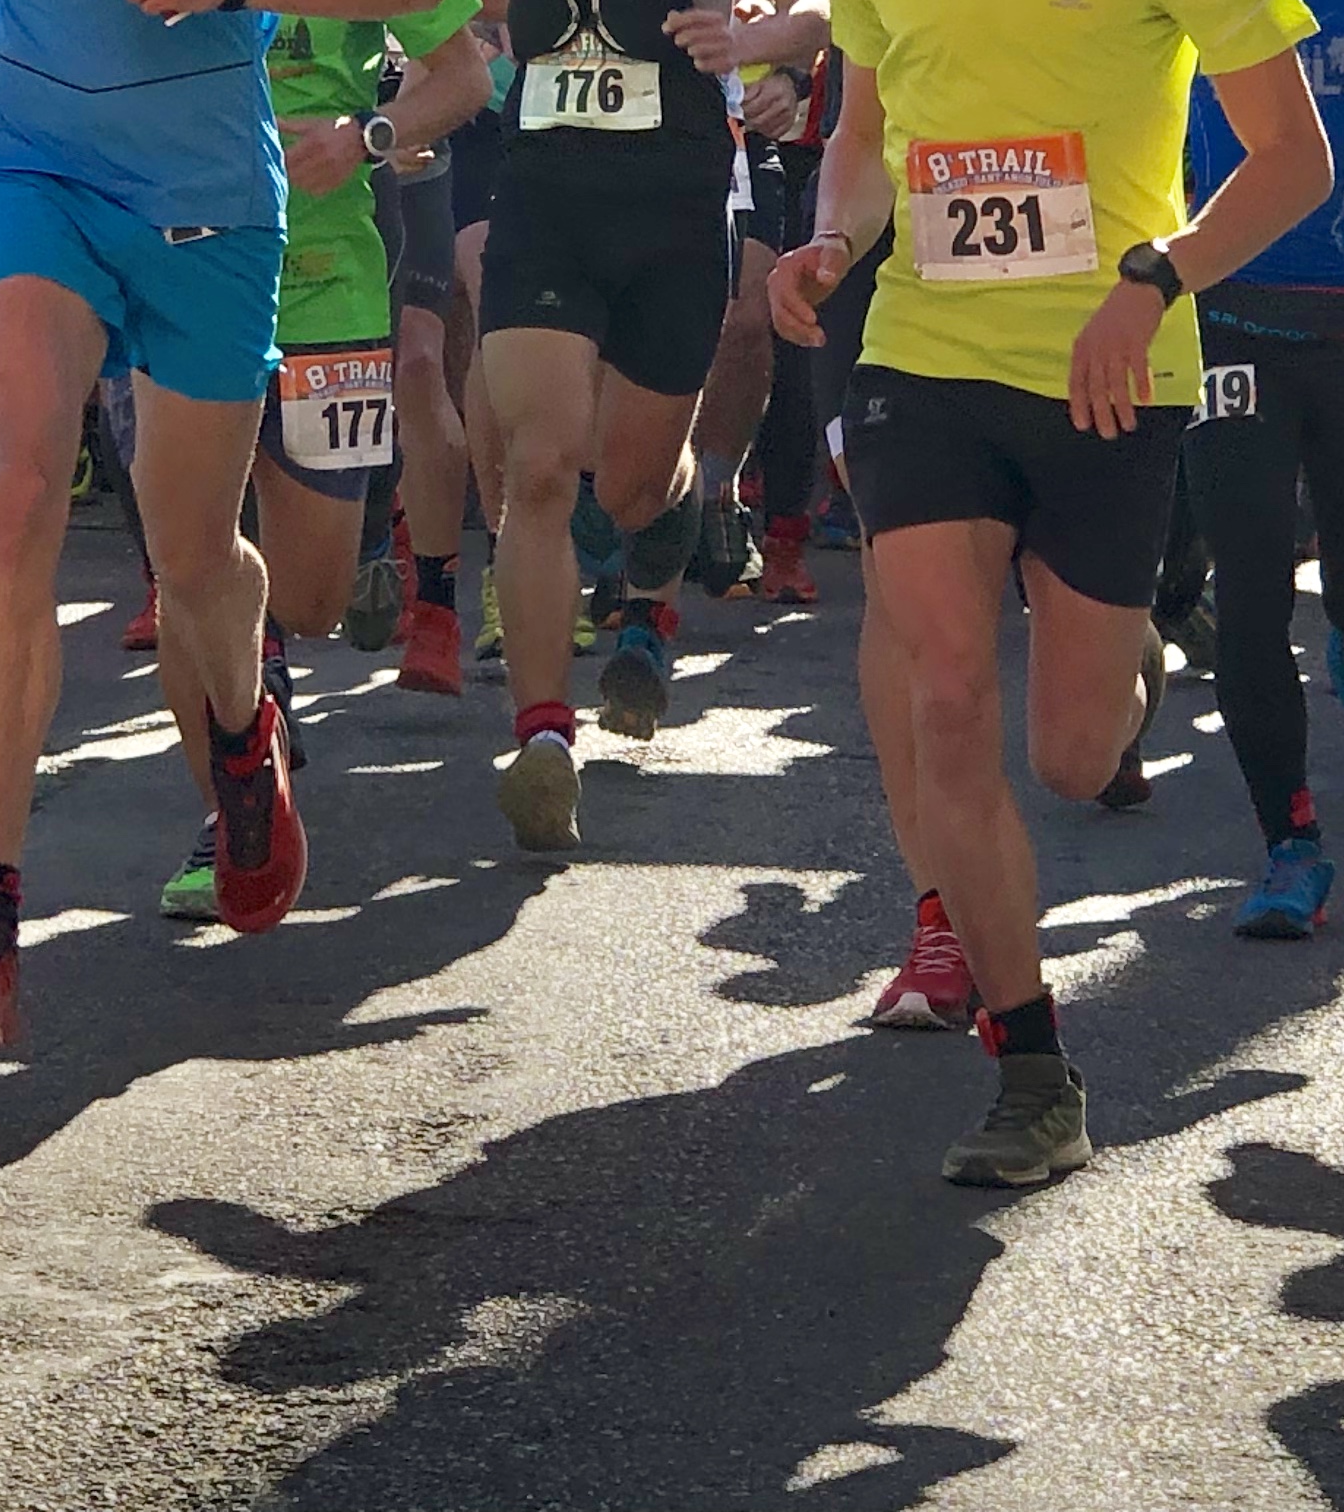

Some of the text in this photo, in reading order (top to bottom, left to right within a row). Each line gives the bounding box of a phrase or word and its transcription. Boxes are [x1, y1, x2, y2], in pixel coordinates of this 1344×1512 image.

[555, 69, 624, 113] 176
[958, 148, 1051, 176] TRAIL
[947, 194, 1045, 257] 231
[322, 399, 387, 450] 177
